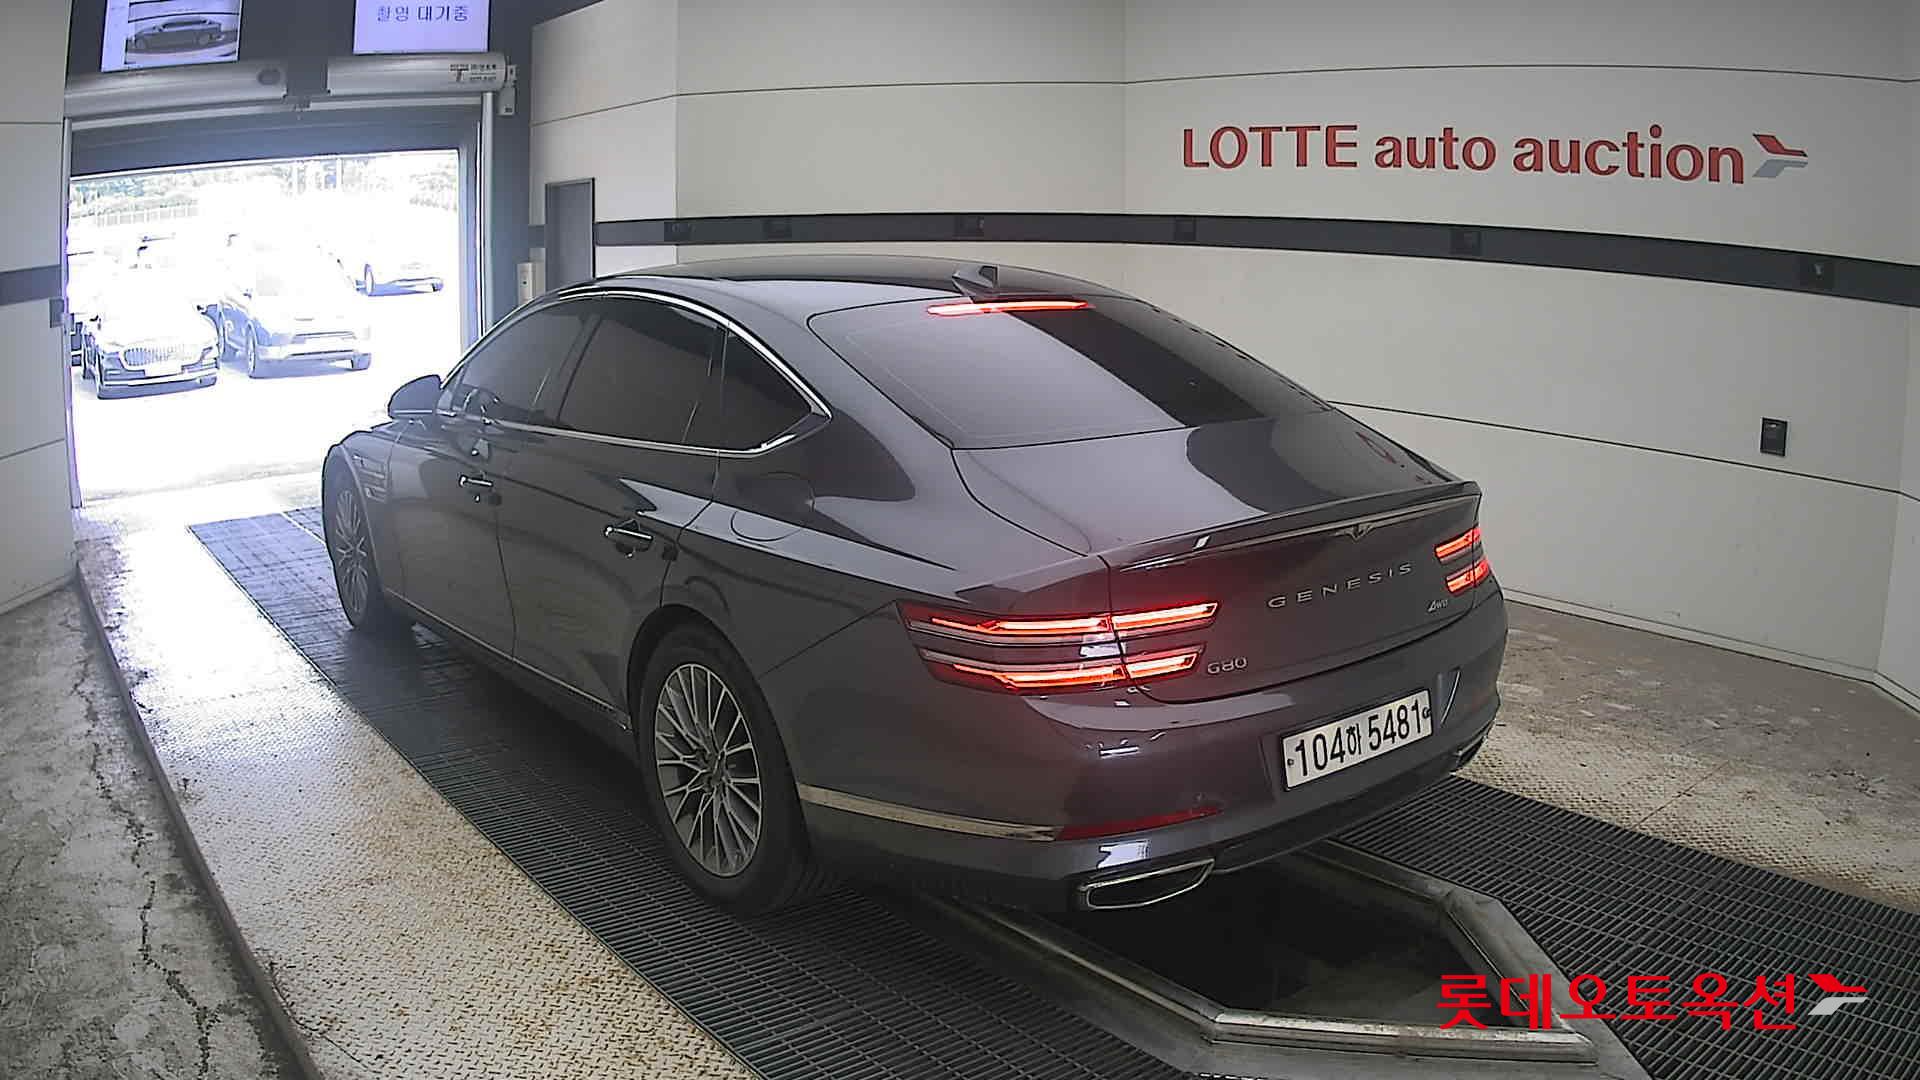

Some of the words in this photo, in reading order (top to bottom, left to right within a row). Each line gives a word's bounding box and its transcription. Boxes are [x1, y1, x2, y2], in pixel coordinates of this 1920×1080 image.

[417, 5, 467, 22] 대기중
[1183, 126, 1360, 169] LOTTE
[1376, 127, 1497, 171] auto
[1513, 125, 1745, 183] auction
[1267, 562, 1412, 609] GENESIS
[1207, 656, 1248, 675] G80
[1295, 723, 1362, 777] 104하
[1367, 698, 1421, 751] 5481
